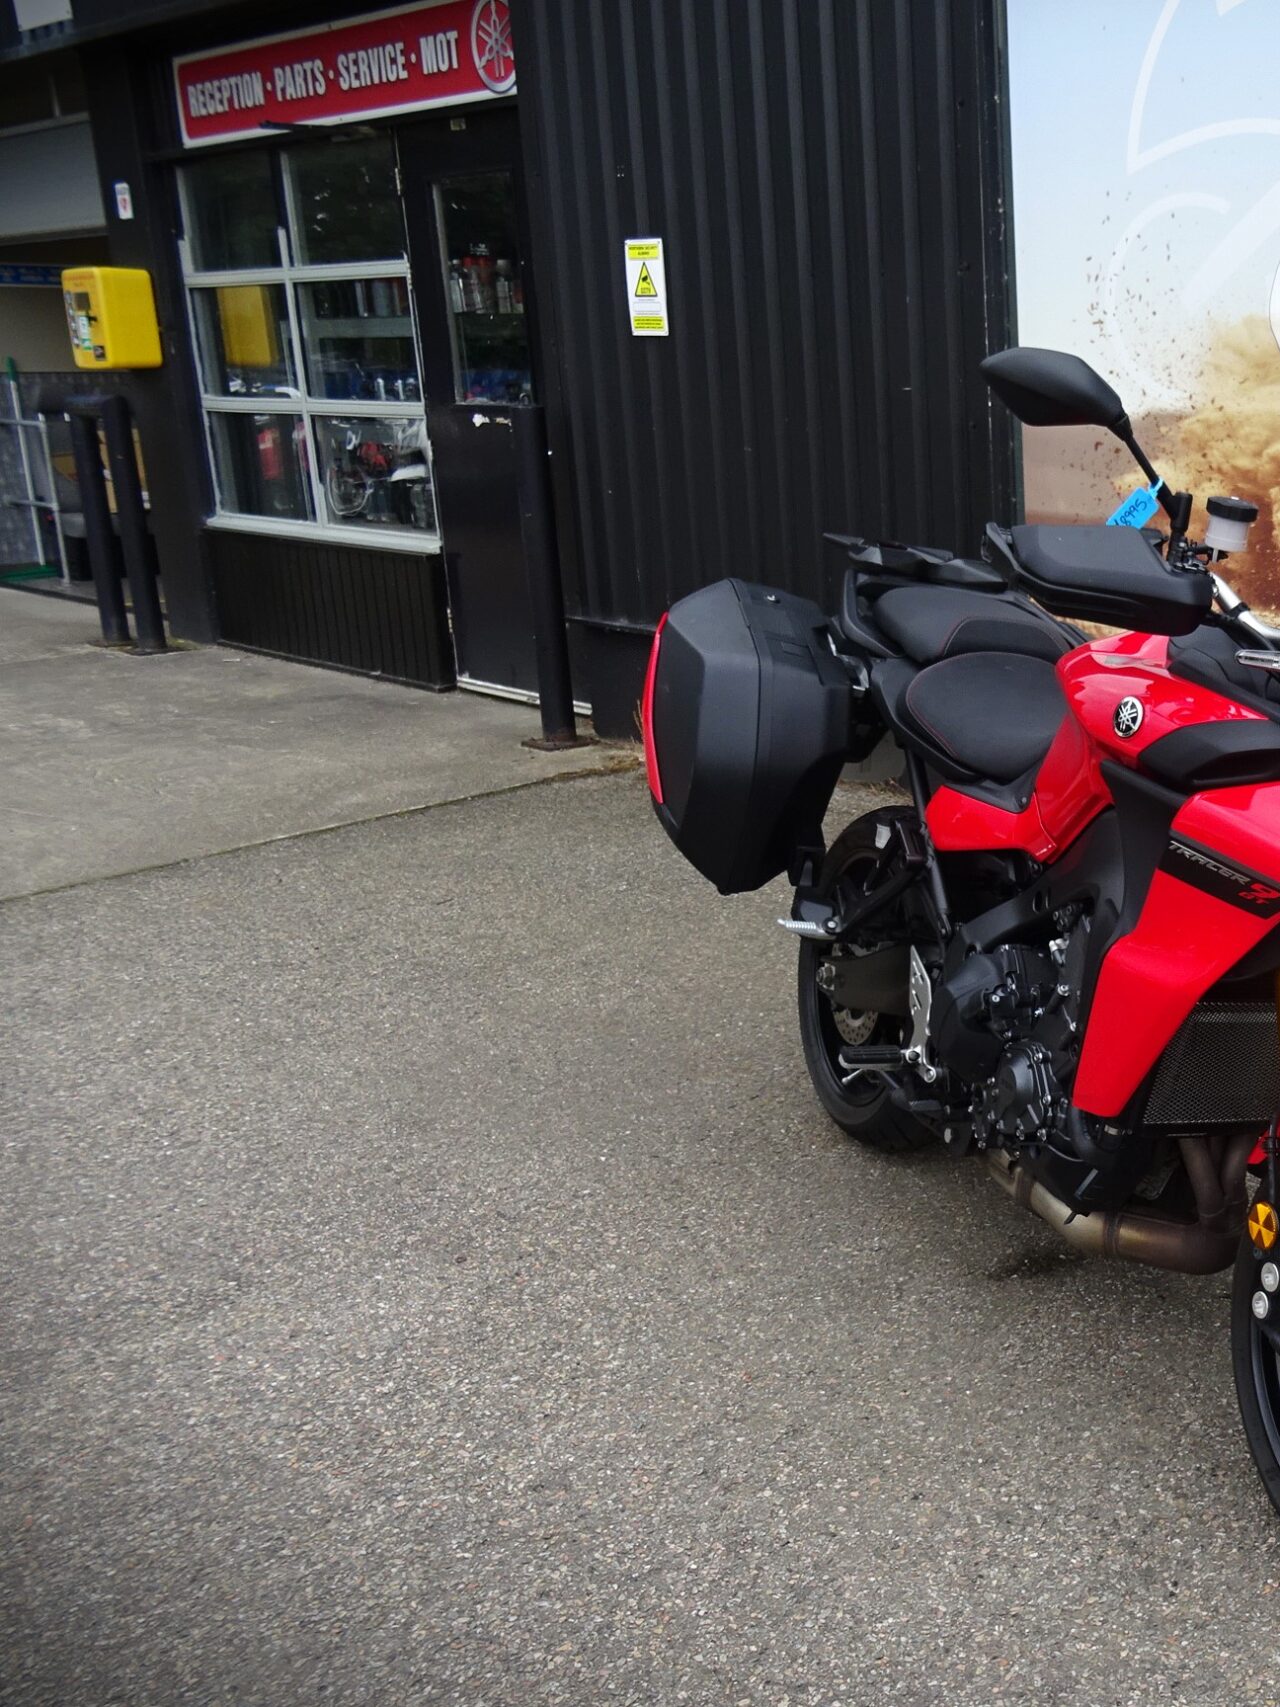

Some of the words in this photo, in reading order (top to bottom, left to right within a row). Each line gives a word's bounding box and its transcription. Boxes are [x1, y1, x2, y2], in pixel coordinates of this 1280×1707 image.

[187, 71, 265, 118] RECEPTION
[273, 59, 327, 102] PARTS
[337, 42, 409, 91] SERVICE
[419, 30, 458, 75] MOT
[1168, 840, 1251, 886] TRACER
